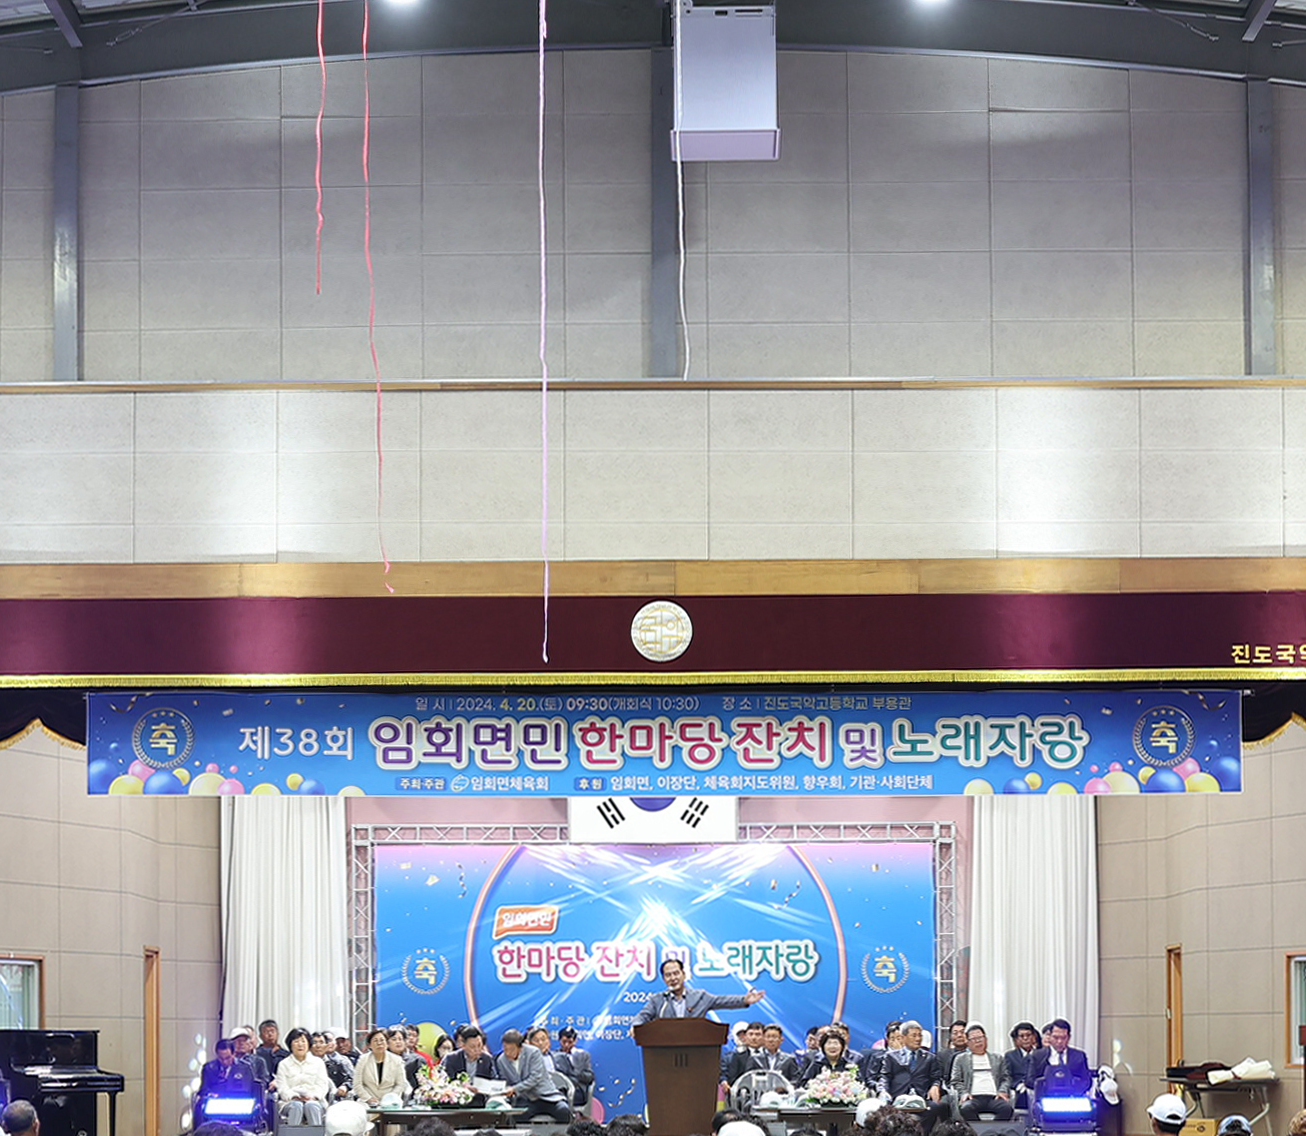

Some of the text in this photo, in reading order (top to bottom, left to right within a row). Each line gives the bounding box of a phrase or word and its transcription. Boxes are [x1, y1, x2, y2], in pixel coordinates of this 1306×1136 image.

[456, 699, 496, 711] 2024.
[500, 699, 513, 711] 4.
[517, 698, 563, 712] 20.(토)
[763, 697, 868, 711] 진도국악고등학교
[148, 722, 179, 756] 축
[239, 725, 354, 761] 제38회
[369, 717, 567, 769] 임회면민
[840, 723, 884, 769] 및
[889, 715, 1091, 769] 노래자랑
[1148, 720, 1179, 755] 축
[470, 776, 549, 791] 임회면체육회
[611, 776, 654, 792] 임회면,
[657, 775, 699, 791] 이장단,
[704, 775, 799, 791] 체육회지도위원,
[803, 775, 846, 791] 향우회,
[850, 775, 933, 791] 기관·사회단체
[495, 941, 816, 981] 한마당 잔치 노래자랑
